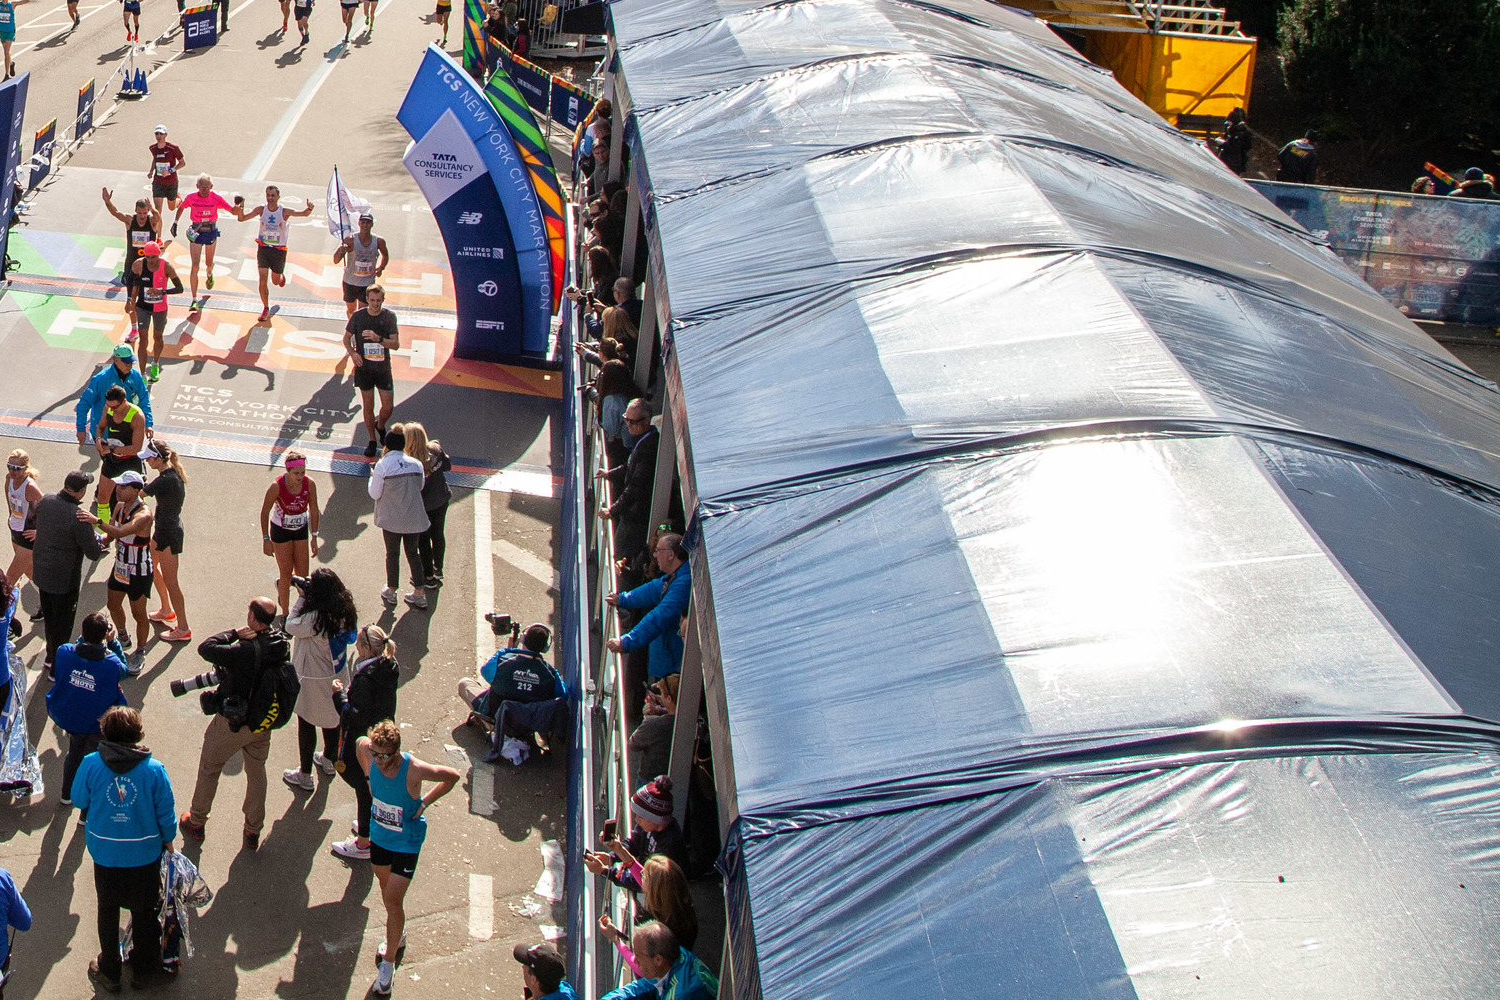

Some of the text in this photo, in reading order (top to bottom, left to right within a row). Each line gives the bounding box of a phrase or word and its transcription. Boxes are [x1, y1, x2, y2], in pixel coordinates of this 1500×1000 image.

[432, 153, 457, 161] TATA
[414, 159, 474, 172] CONSULTANCY
[424, 169, 463, 180] SERVICES
[436, 64, 550, 310] TCS NEW YORK CITY MARATHON
[1339, 196, 1413, 207] PROUD PARTNERS
[1353, 216, 1394, 224] CONSULTANCY
[476, 320, 504, 330] ESPN
[47, 308, 436, 371] FINISH
[179, 384, 234, 398] TCS
[172, 402, 302, 422] MARATHON
[176, 393, 356, 419] NEW YORK CITY
[169, 414, 352, 439] TATA CONSULTANCY SERVICES
[70, 677, 96, 689] PHOTO
[517, 682, 533, 690] 212
